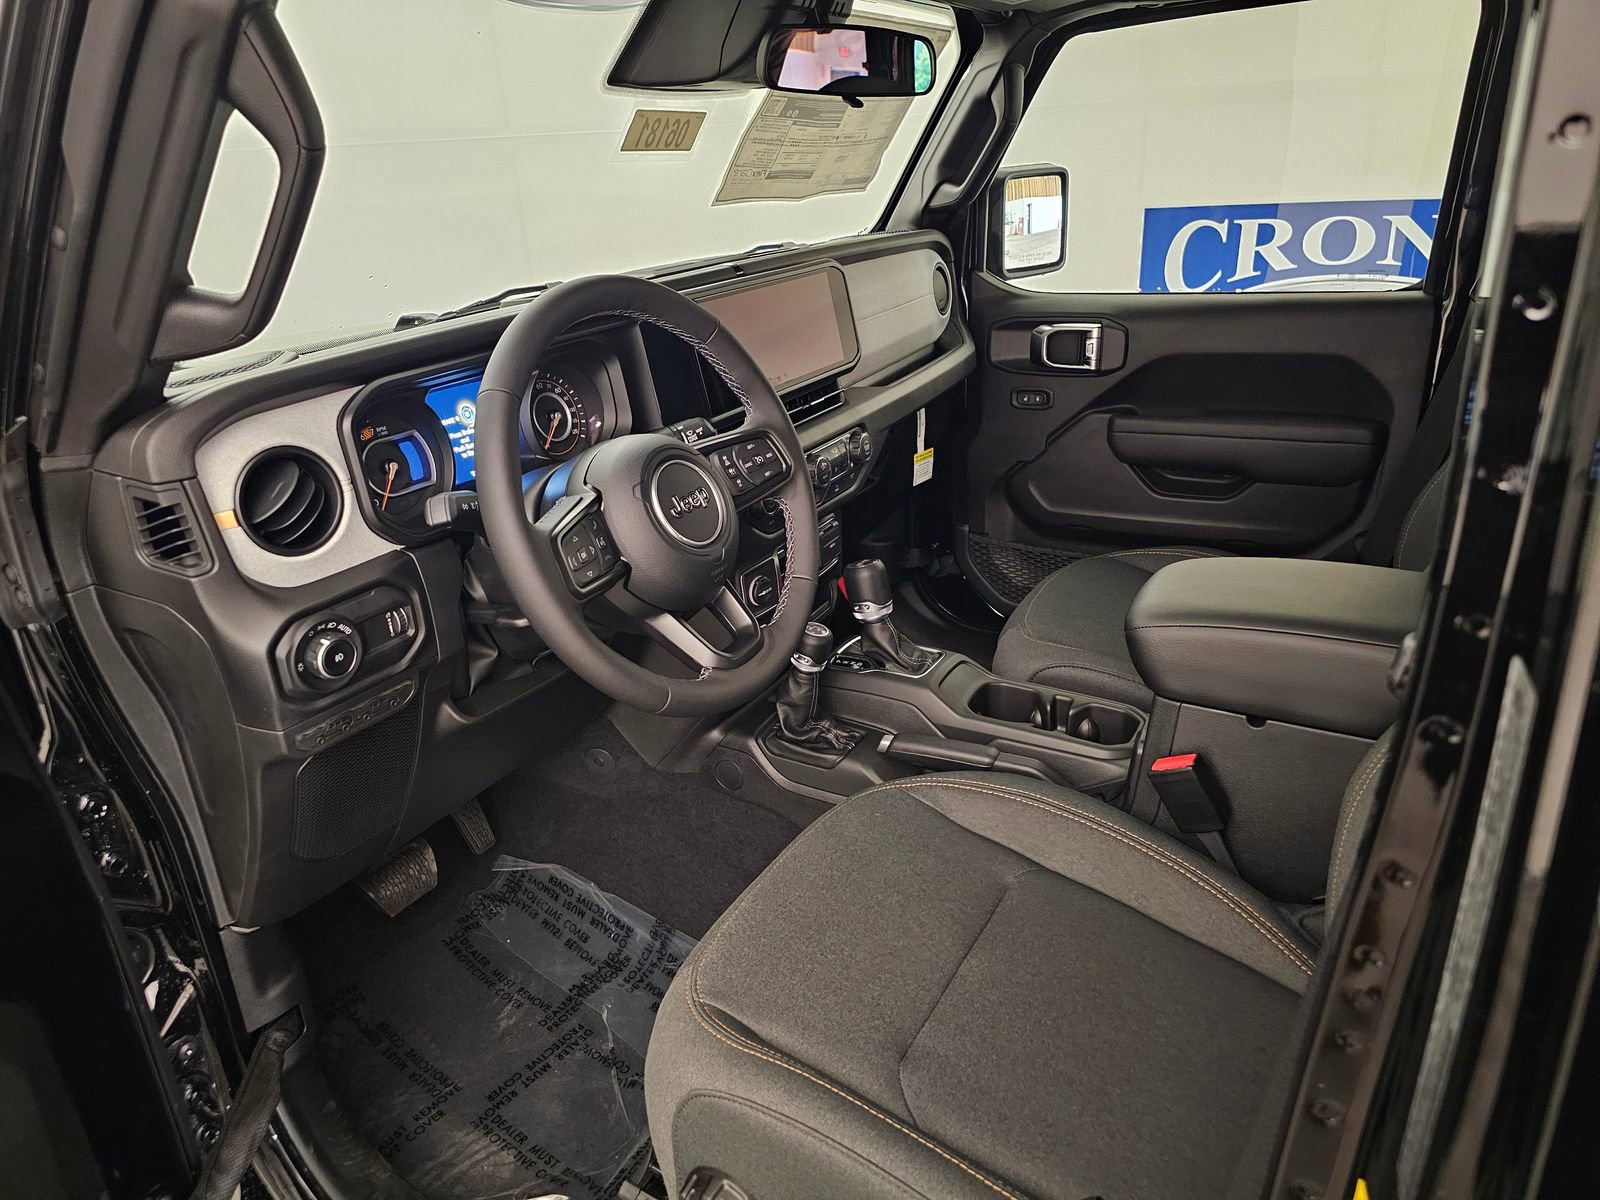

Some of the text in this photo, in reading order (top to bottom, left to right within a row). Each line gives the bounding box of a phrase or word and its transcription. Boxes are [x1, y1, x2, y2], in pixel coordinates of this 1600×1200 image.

[670, 486, 710, 519] Jeep
[337, 623, 353, 635] AUTO
[526, 874, 560, 902] REMOVE
[548, 874, 575, 898] COVER
[562, 899, 586, 920] MUST
[576, 893, 626, 932] PROTECTIVE
[490, 967, 518, 990] MUST
[515, 986, 553, 1014] REMOVE
[495, 988, 525, 1010] COVER
[524, 1023, 586, 1072] PROTECTIVE
[554, 1027, 594, 1061] DEALER
[485, 1072, 523, 1102] COVER
[521, 1061, 553, 1089] MUST
[406, 1109, 446, 1142] COVER
[490, 1113, 529, 1145] DEALER
[530, 1143, 561, 1169] MUST
[479, 1125, 538, 1172] PROTECTIVE
